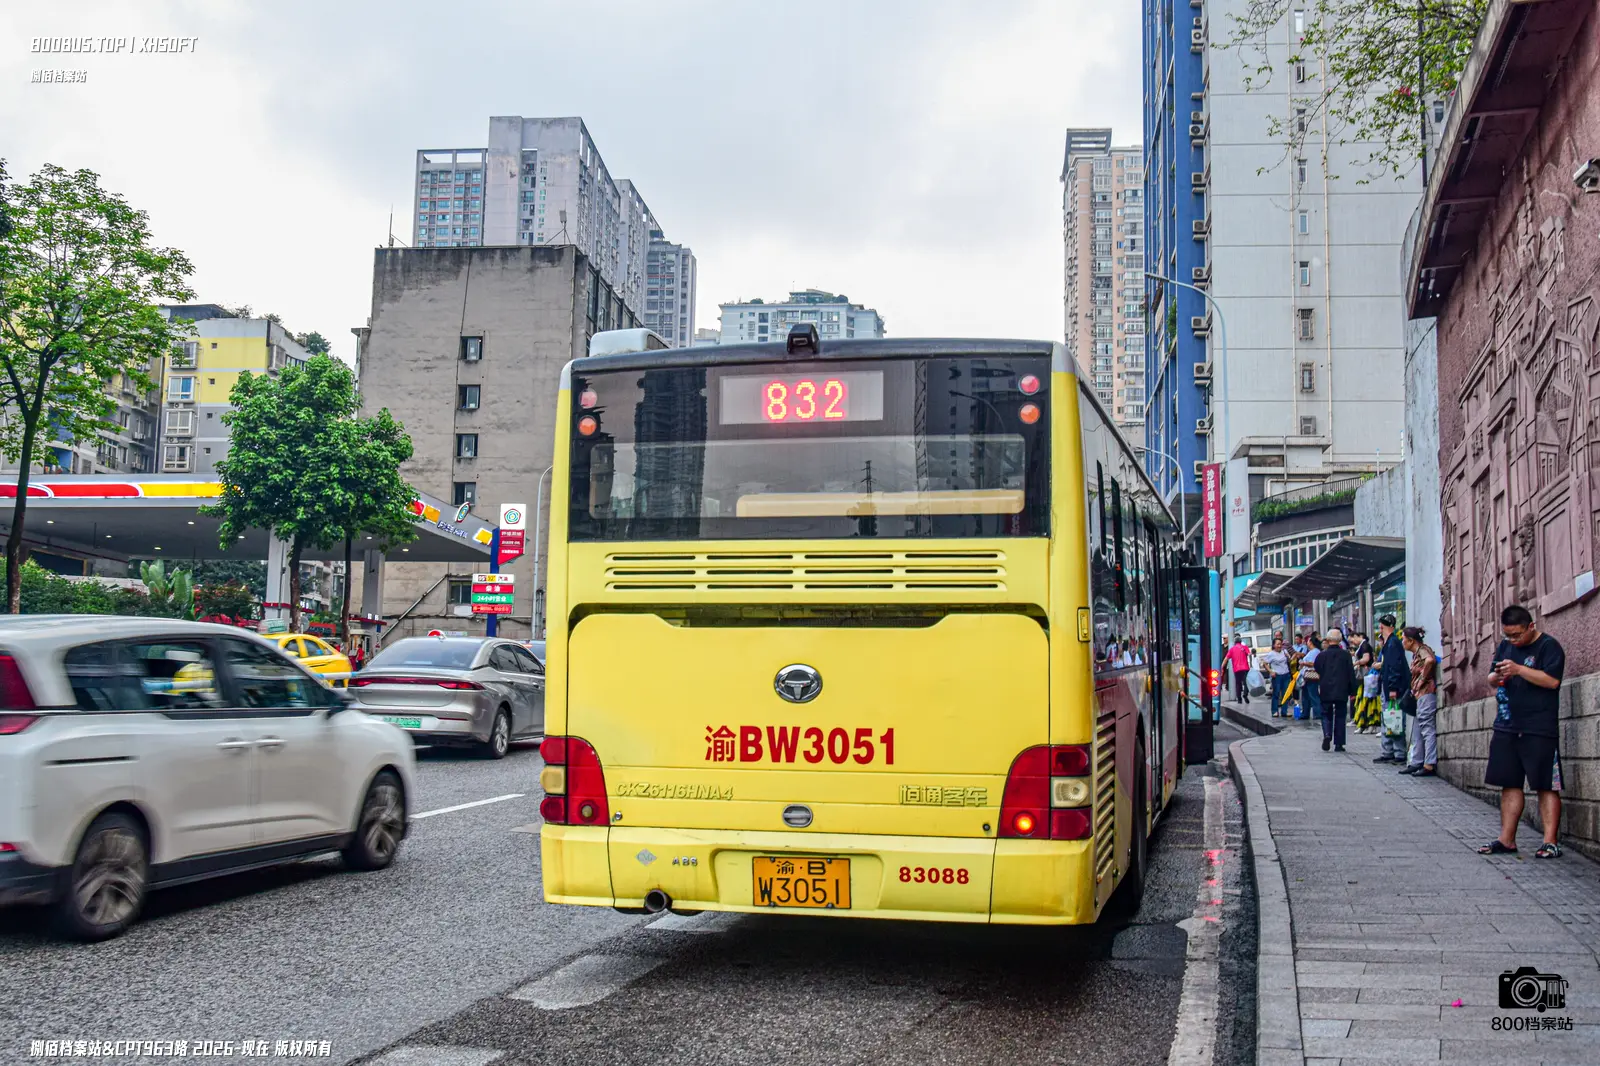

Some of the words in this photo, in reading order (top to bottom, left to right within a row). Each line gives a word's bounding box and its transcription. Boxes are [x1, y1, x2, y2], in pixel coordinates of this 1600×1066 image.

[765, 380, 845, 421] 832
[705, 725, 895, 765] 渝BW3051
[616, 783, 733, 800] CKZ6116HNA4
[900, 785, 988, 807] 恒通客车
[672, 856, 698, 867] ABS
[899, 866, 969, 884] 83088
[758, 877, 840, 904] W3051
